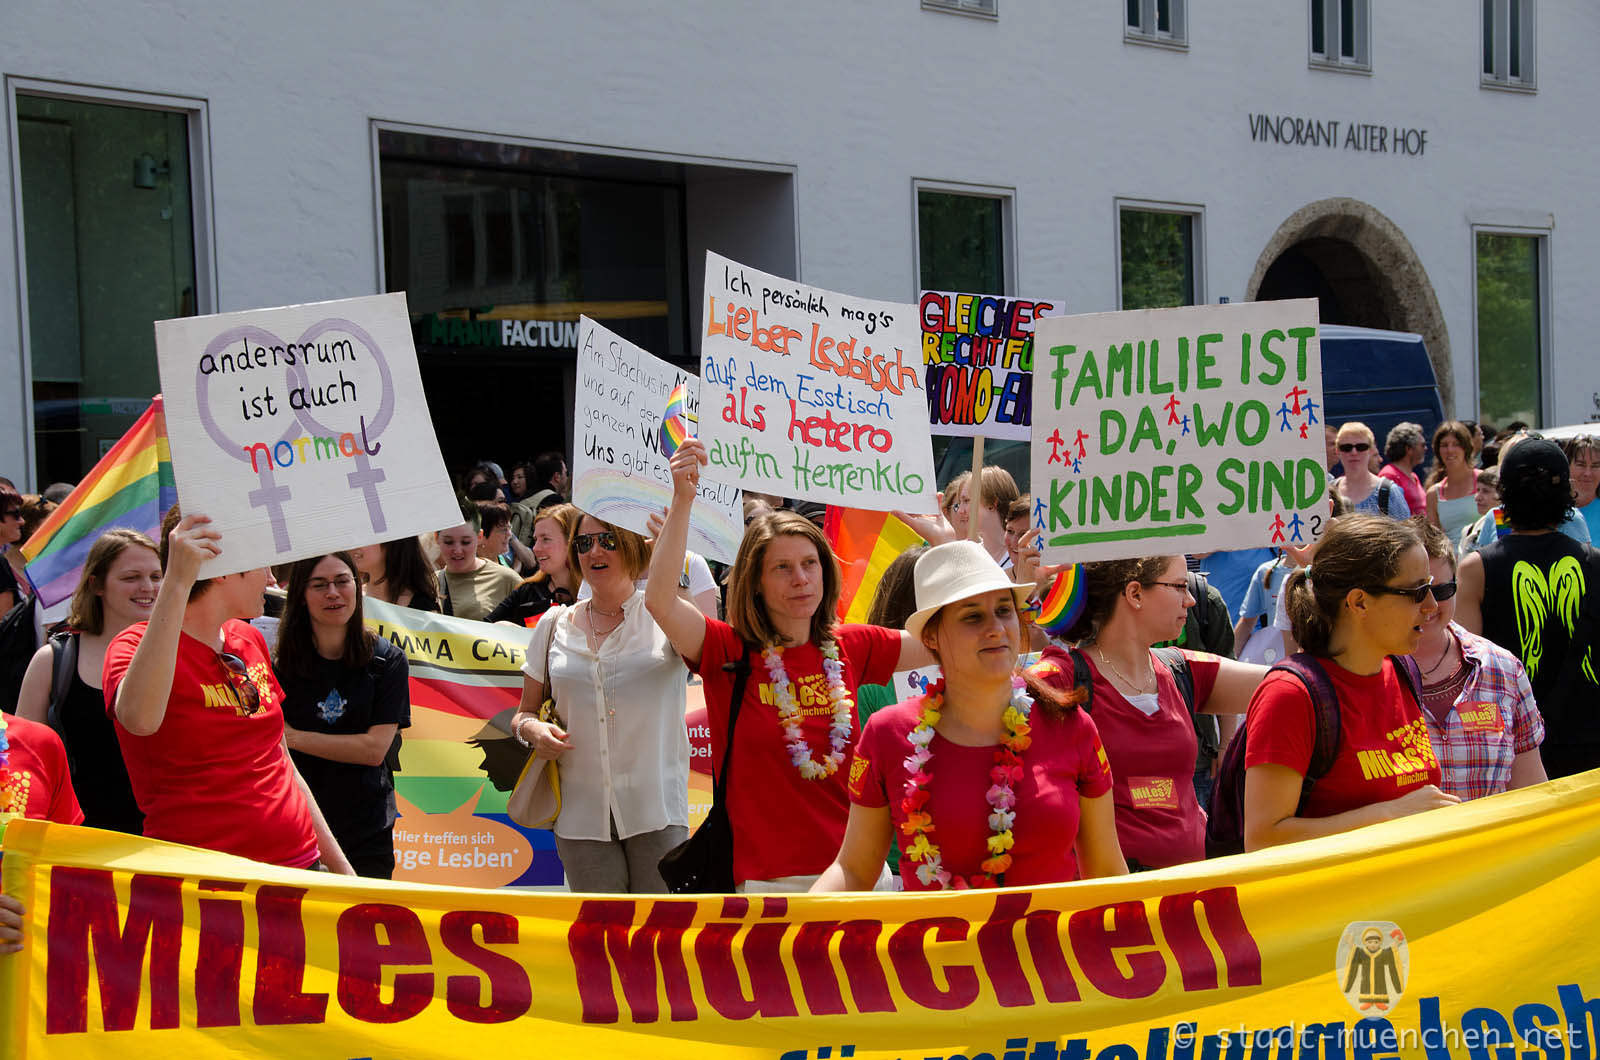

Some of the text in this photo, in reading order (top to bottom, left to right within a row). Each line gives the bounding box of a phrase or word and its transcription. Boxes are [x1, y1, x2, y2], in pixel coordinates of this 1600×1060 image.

[1248, 113, 1428, 156] VINORANT ALTER HOF
[725, 265, 895, 334] Ich persönlich mag's
[706, 295, 803, 356] Lieber
[921, 331, 1003, 367] RECHT
[199, 338, 356, 376] andersrum
[583, 327, 605, 368] Am
[659, 374, 670, 397] in
[1049, 327, 1317, 410] FAMILIE IST
[239, 371, 358, 421] ist auch
[583, 372, 660, 423] und auf der
[705, 355, 894, 420] auf dem Esstisch
[243, 416, 381, 474] normal
[583, 405, 635, 440] ganzen
[722, 387, 893, 454] als hetero
[1100, 399, 1270, 456] DA, WO
[584, 433, 614, 464] Uns
[622, 449, 650, 478] gibt
[653, 463, 671, 484] es
[792, 446, 924, 496] Herrenklo
[1049, 458, 1326, 533] KINDER SIND
[1309, 514, 1323, 542] ?
[472, 639, 526, 664] CAF
[1357, 748, 1425, 781] MiLes
[393, 830, 495, 845] Hier treffen sich
[46, 864, 1264, 1036] MiLes München
